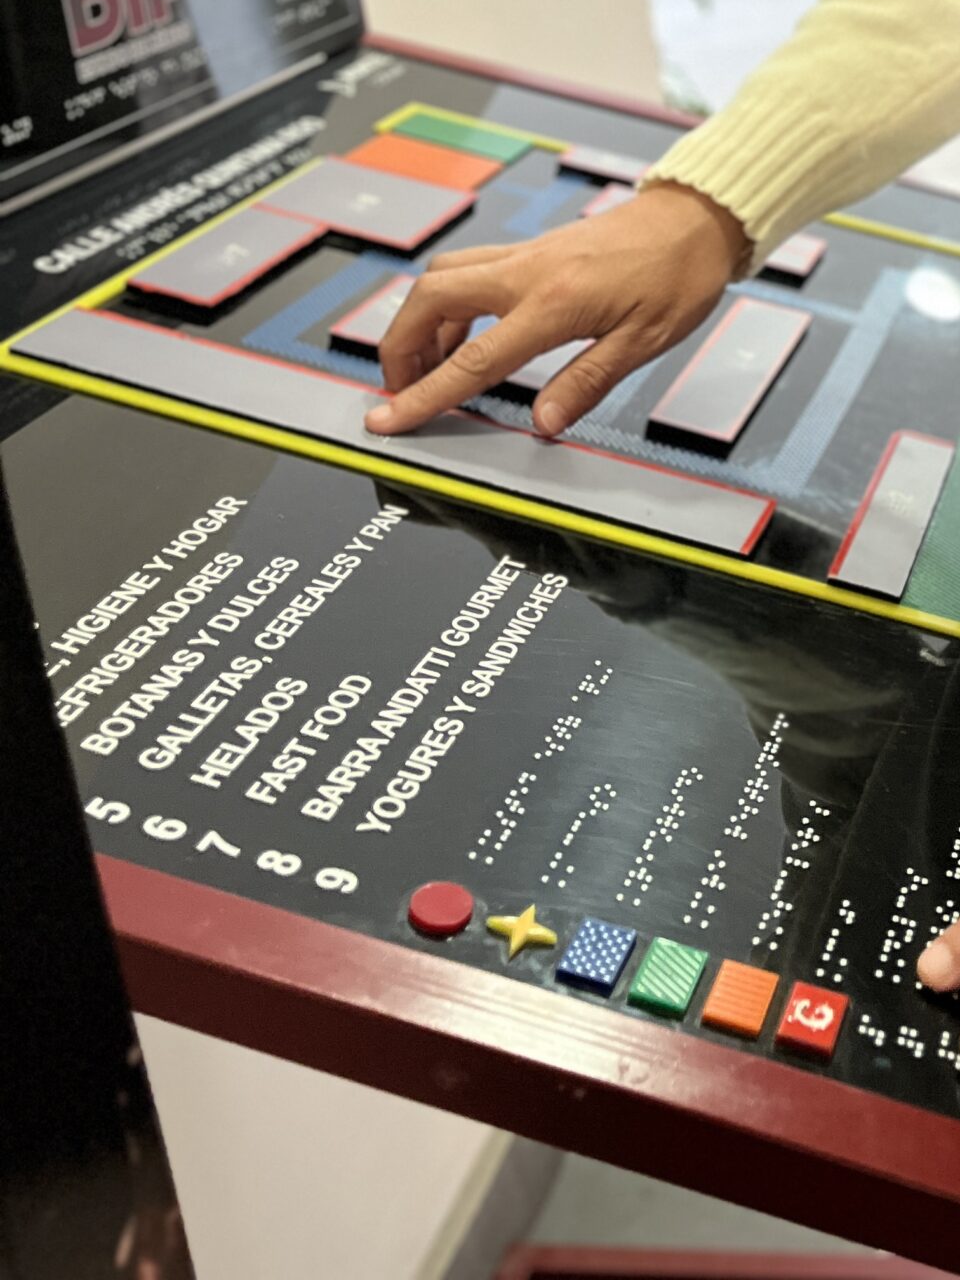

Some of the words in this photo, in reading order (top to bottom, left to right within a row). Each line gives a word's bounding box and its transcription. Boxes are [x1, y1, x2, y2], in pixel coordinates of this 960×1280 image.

[34, 225, 124, 274] CALLE
[51, 572, 161, 654] HIGIENE
[142, 555, 174, 572] Y
[162, 495, 248, 559] HOGAR
[54, 552, 244, 727] EFRIGERADORES
[80, 649, 205, 756] BOTANAS
[187, 629, 220, 647] Y
[207, 556, 300, 633] DULCES
[85, 797, 131, 824] 5
[138, 656, 273, 770] GALLETAS,
[254, 552, 362, 651] CEREALES
[344, 536, 374, 552] Y
[359, 504, 409, 540] PAN
[142, 815, 188, 841] 6
[190, 677, 308, 788] HELADOS
[195, 830, 242, 858] 7
[244, 737, 317, 804] FAST
[300, 674, 372, 741] FOOD
[256, 849, 302, 877] 8
[301, 736, 390, 822] BARRA
[370, 646, 456, 739] ANDATTI
[440, 555, 526, 647] GOURMET
[315, 867, 359, 894] 9
[355, 716, 465, 833] YOGURES
[444, 695, 477, 713] Y
[461, 572, 569, 698] SANDWICHES
